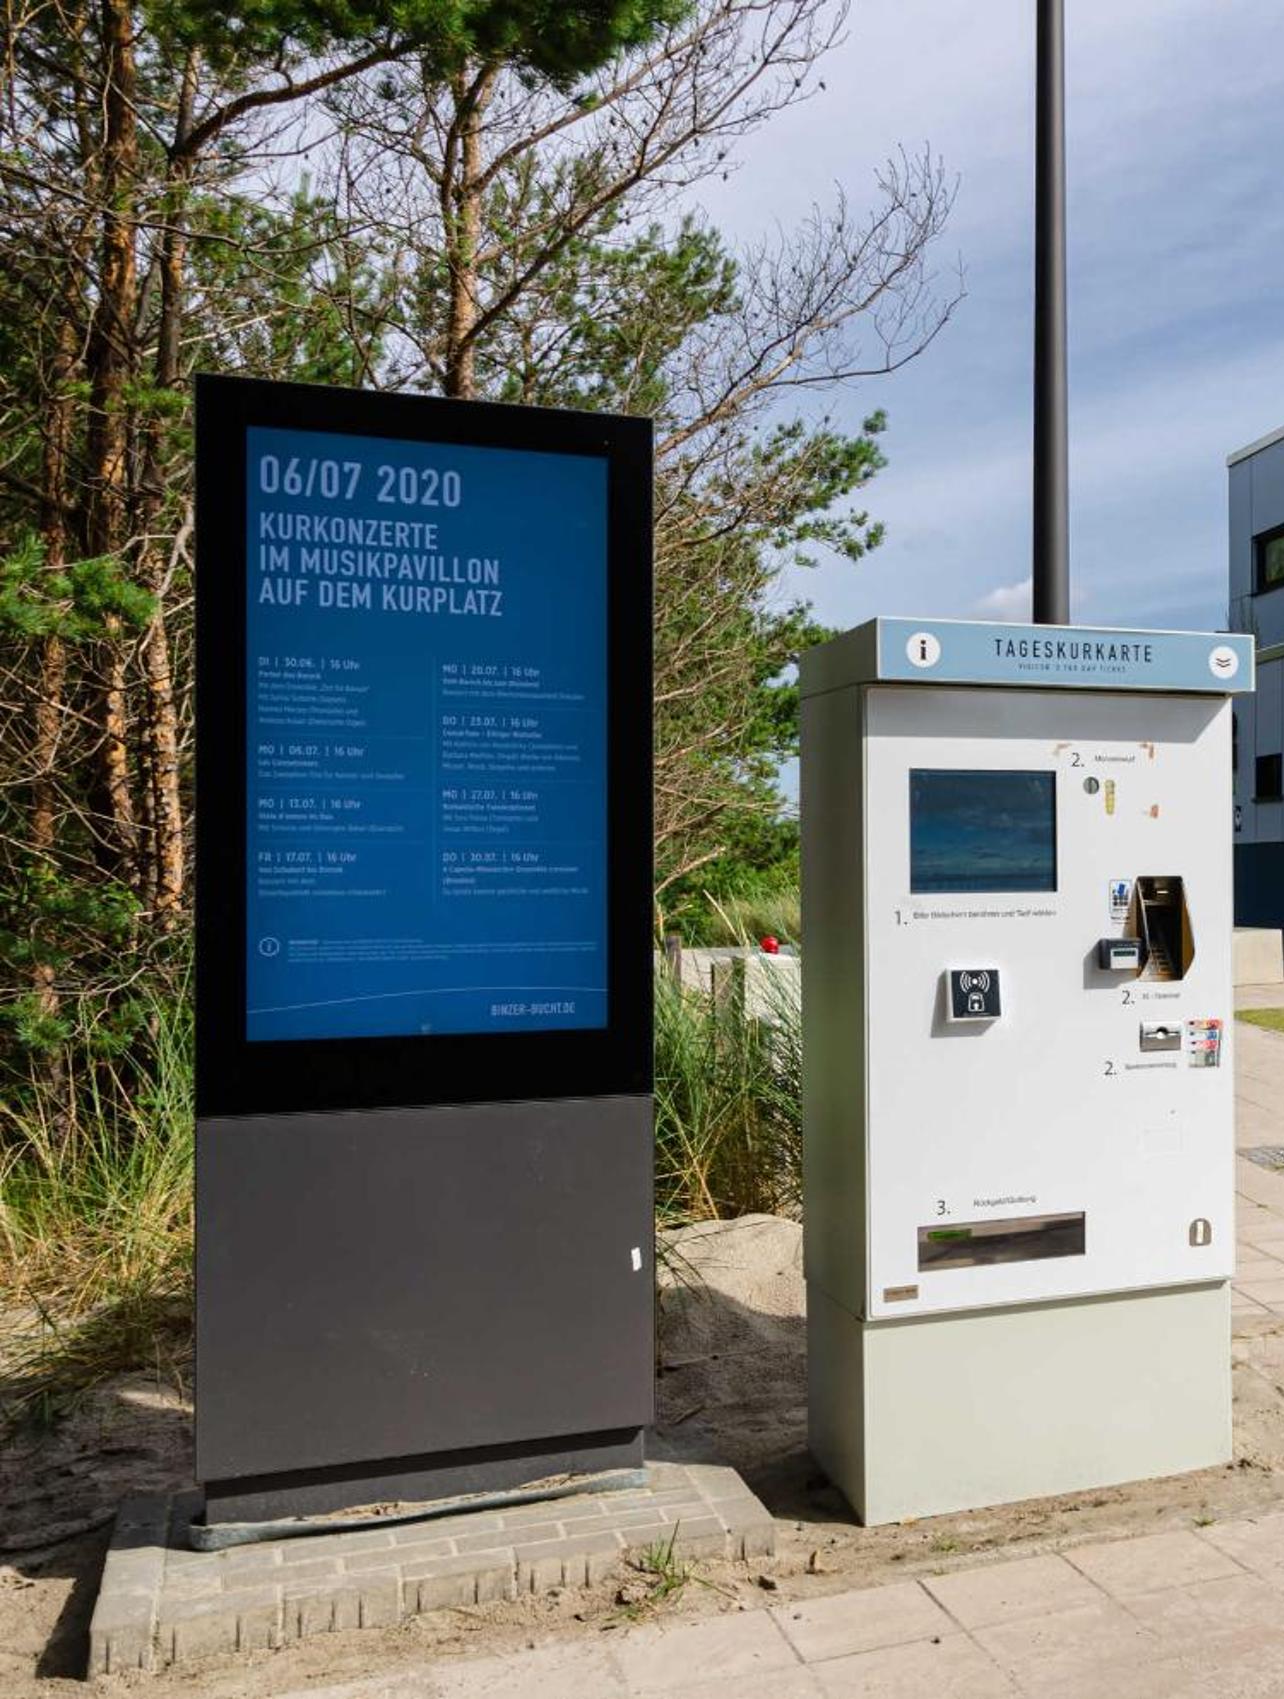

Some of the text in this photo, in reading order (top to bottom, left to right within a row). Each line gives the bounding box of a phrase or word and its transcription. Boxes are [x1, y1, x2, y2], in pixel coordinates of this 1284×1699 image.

[260, 455, 462, 507] 06/07 2020
[259, 511, 439, 550] KURKONZERTE
[259, 544, 500, 585] IM MUSIKPAVILLON
[259, 577, 503, 617] AUF DEM KURPLATZ
[994, 638, 1153, 663] TAGESKURKARTE
[1071, 752, 1085, 767] 2.
[894, 910, 908, 925] 1.
[1122, 990, 1135, 1004] 2.
[1104, 1061, 1118, 1076] 2.
[937, 1200, 951, 1215] 3.
